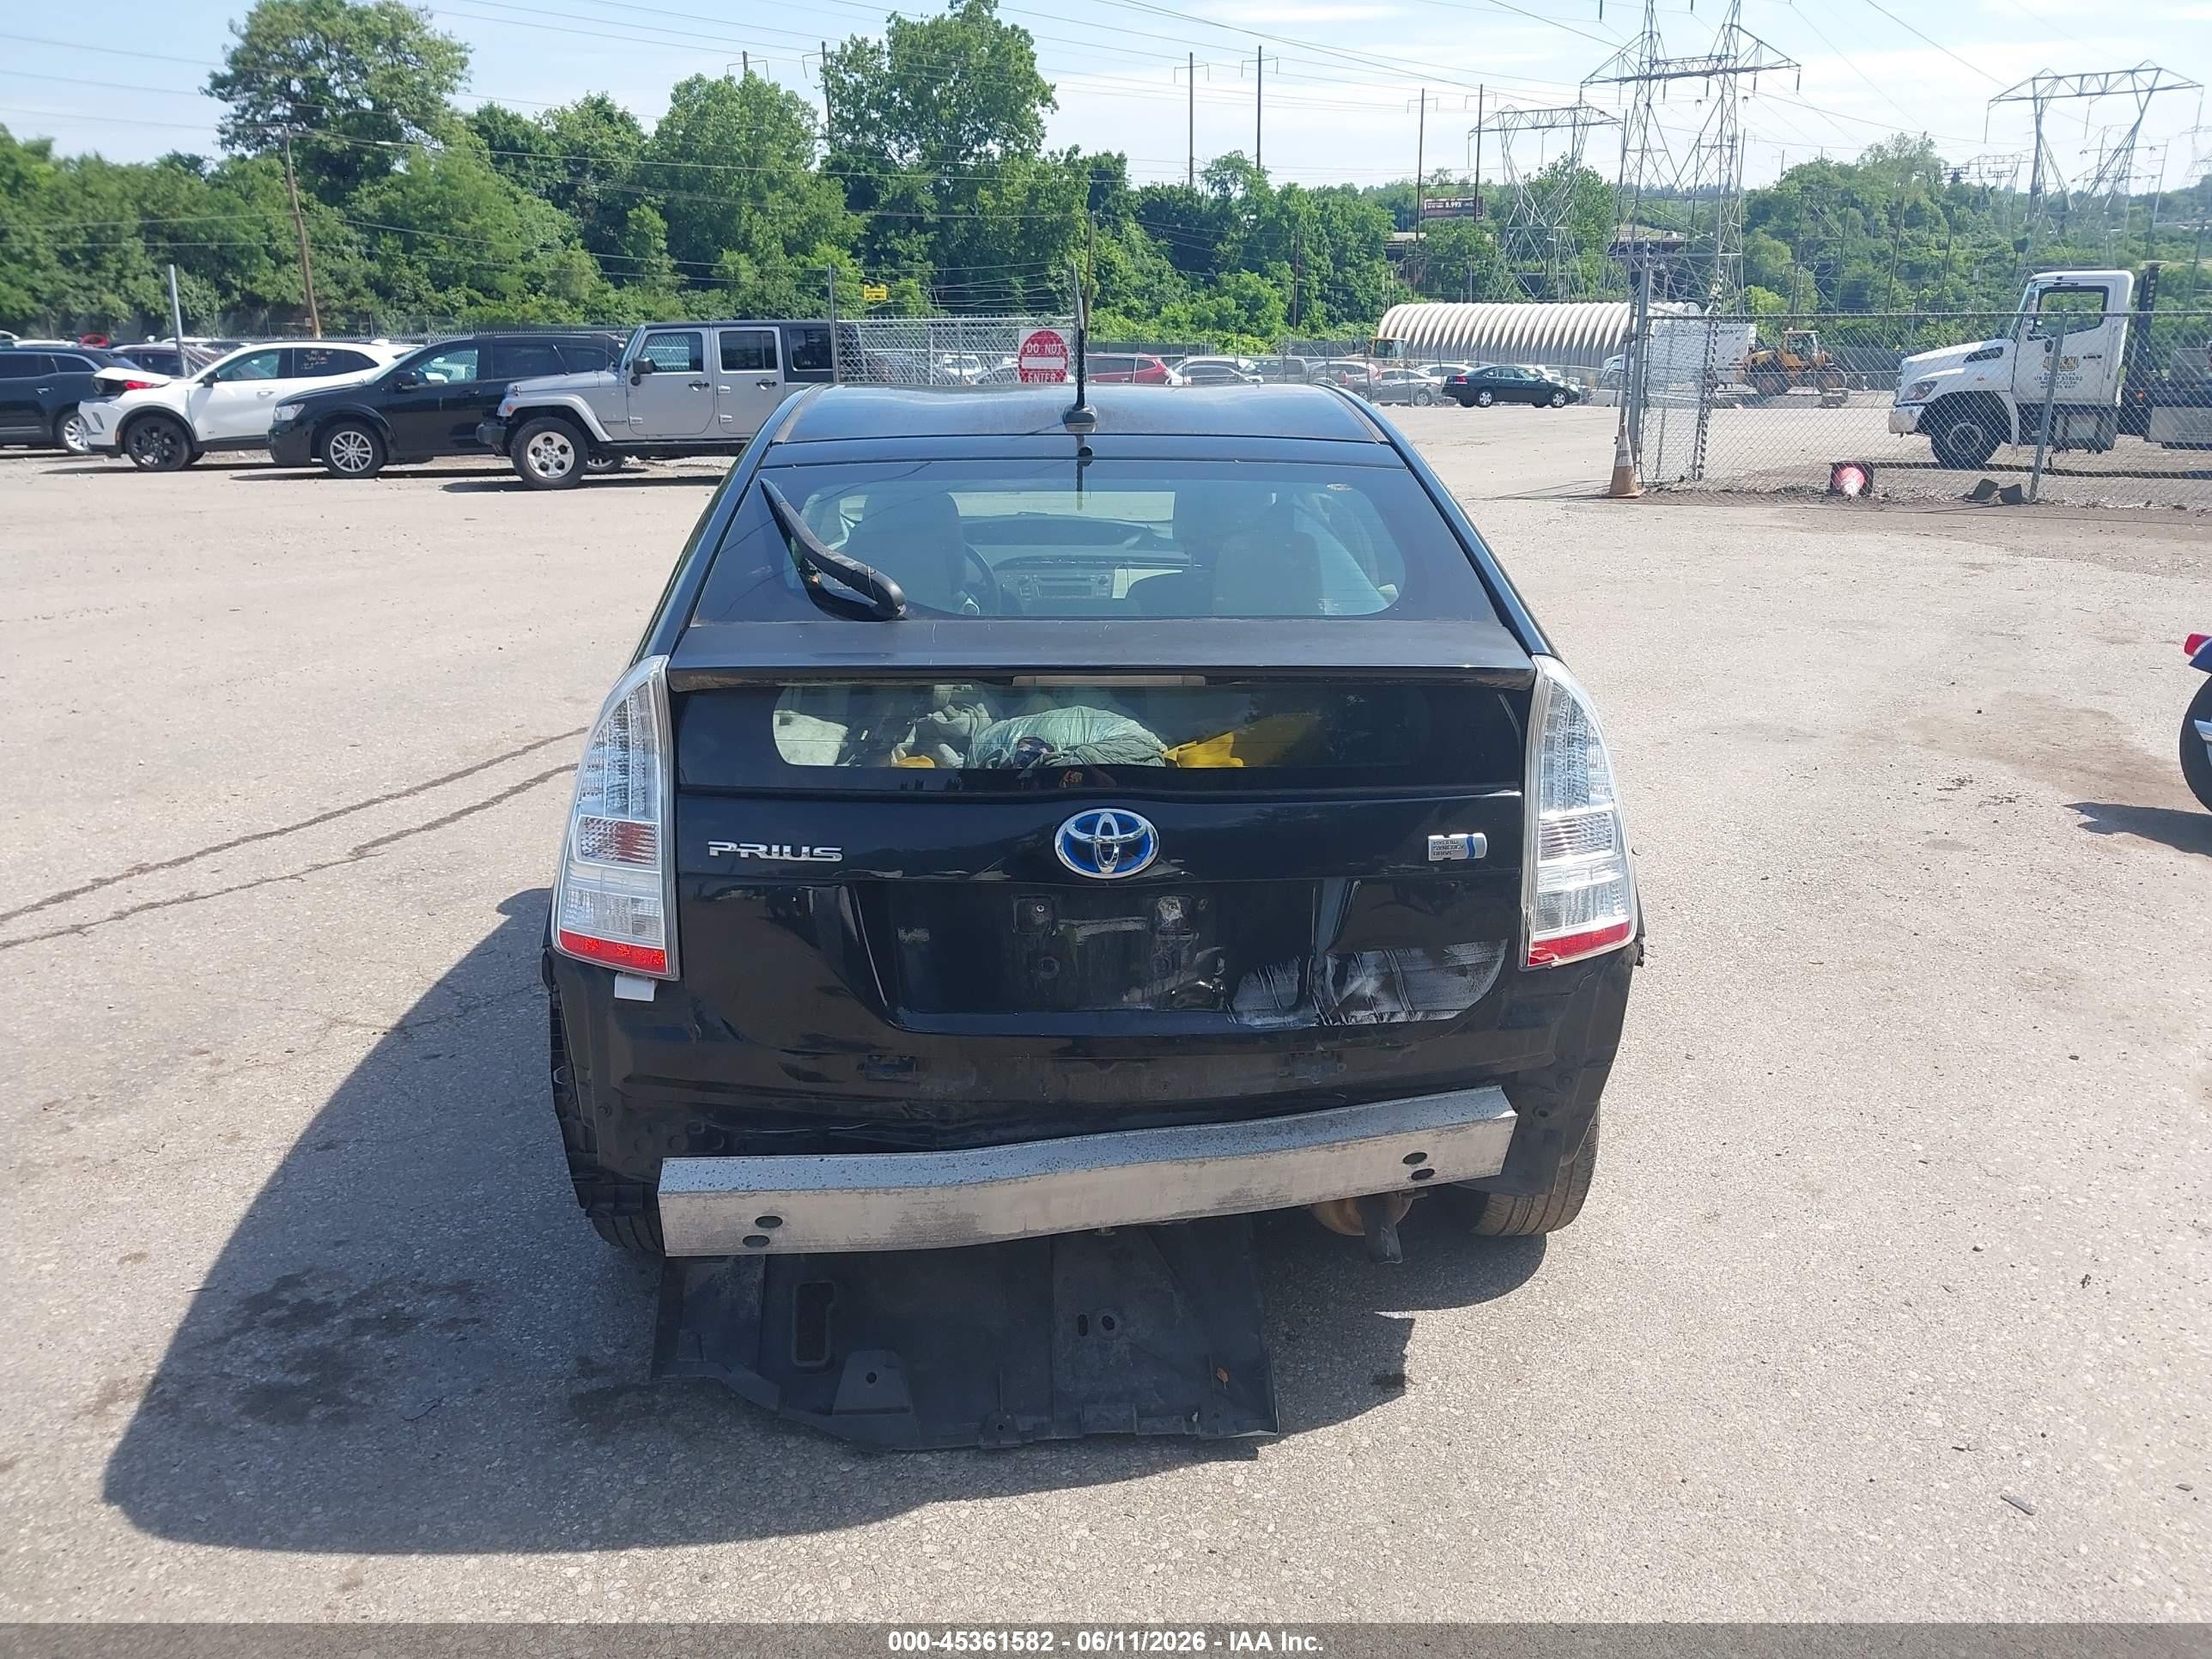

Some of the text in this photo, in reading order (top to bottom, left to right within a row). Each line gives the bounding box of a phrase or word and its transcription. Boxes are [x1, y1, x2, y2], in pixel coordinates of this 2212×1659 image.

[1026, 343, 1062, 353] DO NOT
[1028, 373, 1057, 384] ENTER
[708, 841, 842, 862] PRIUS
